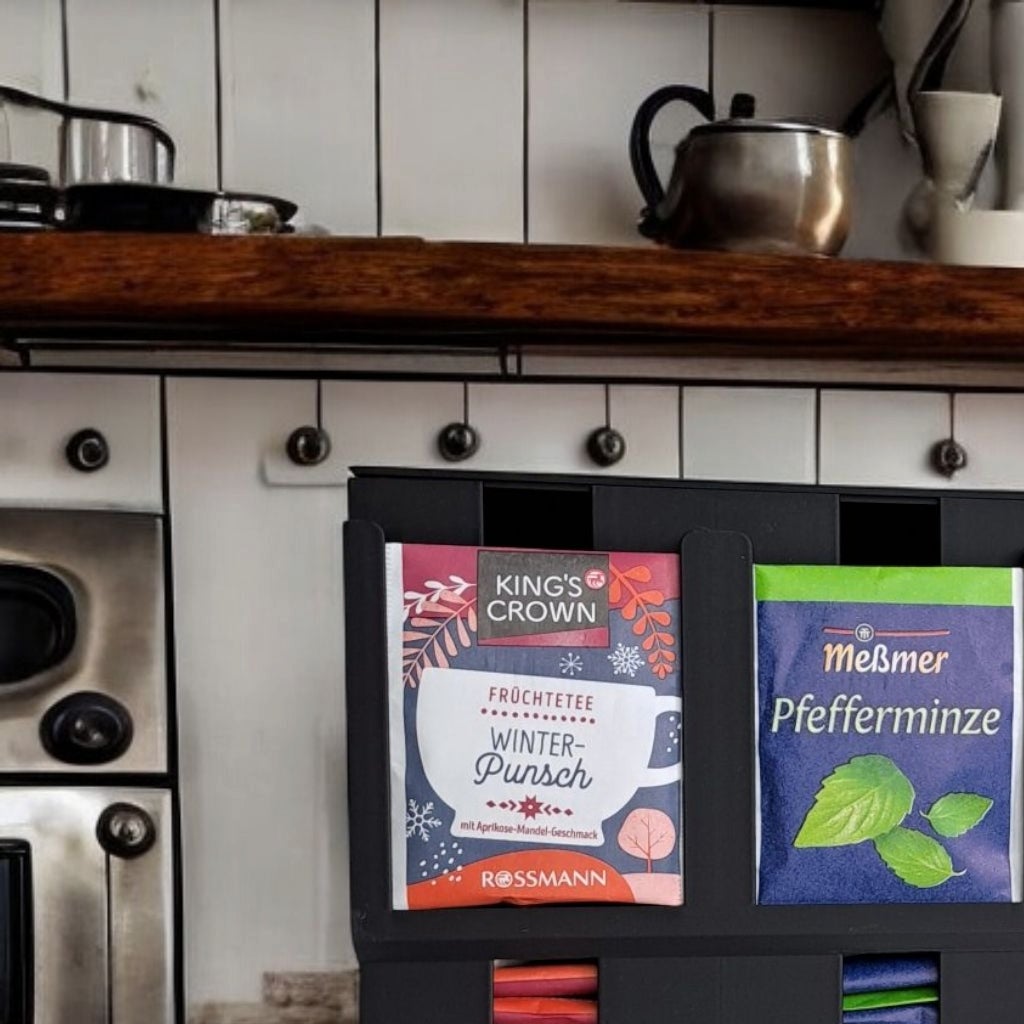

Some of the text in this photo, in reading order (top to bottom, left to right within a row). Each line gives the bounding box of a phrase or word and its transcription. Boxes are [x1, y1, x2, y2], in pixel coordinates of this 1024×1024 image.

[496, 574, 583, 598] KING'S
[487, 600, 596, 623] CROWN
[823, 643, 949, 674] Meßmer
[488, 686, 594, 711] FRÜCHTETEE
[771, 694, 1001, 735] Pfefferminze
[490, 726, 586, 757] WINTER-
[473, 752, 593, 789] Punsch
[460, 820, 598, 840] mit Aprikose-Mandel-Geschmack
[481, 869, 607, 888] ROSSMANN
